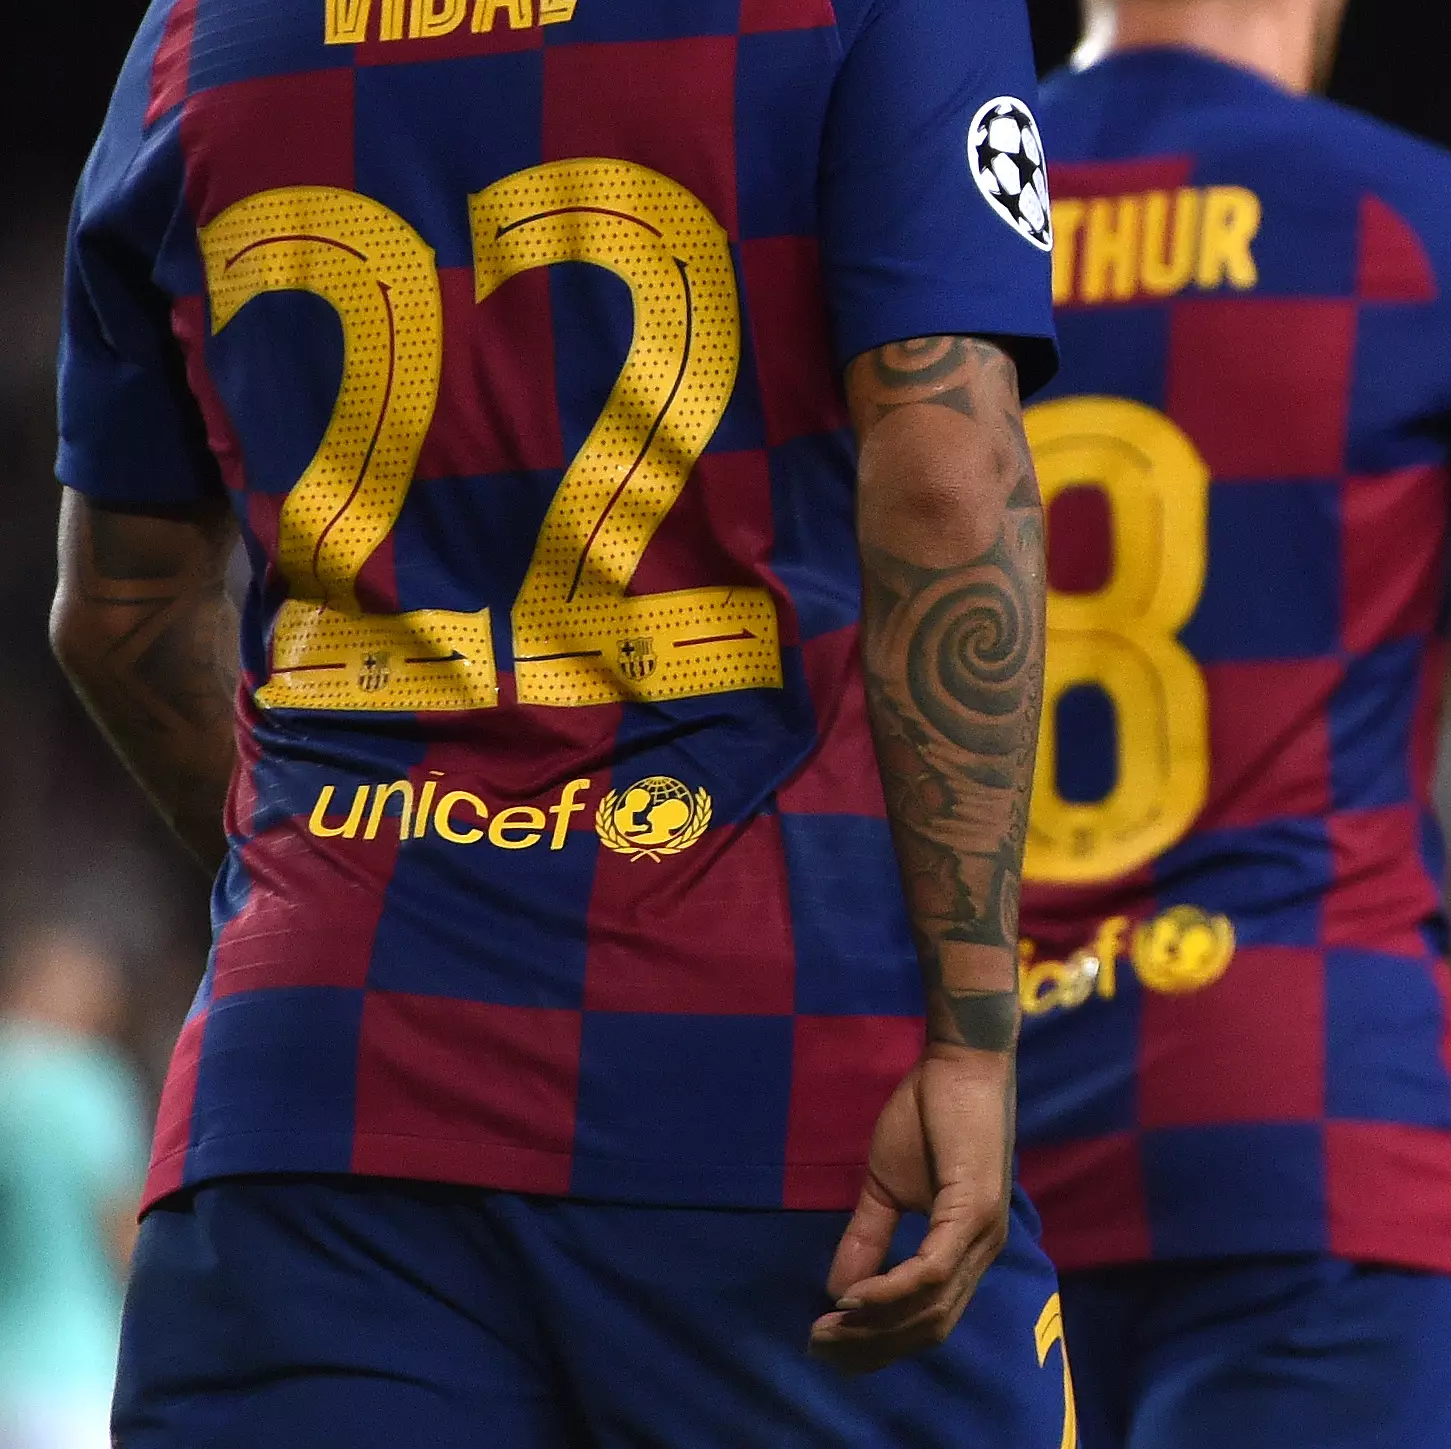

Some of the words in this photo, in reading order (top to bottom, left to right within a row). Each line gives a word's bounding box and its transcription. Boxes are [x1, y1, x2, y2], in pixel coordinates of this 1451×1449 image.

[199, 157, 783, 711] 22
[1020, 395, 1211, 885] 8
[308, 771, 591, 851] unicef
